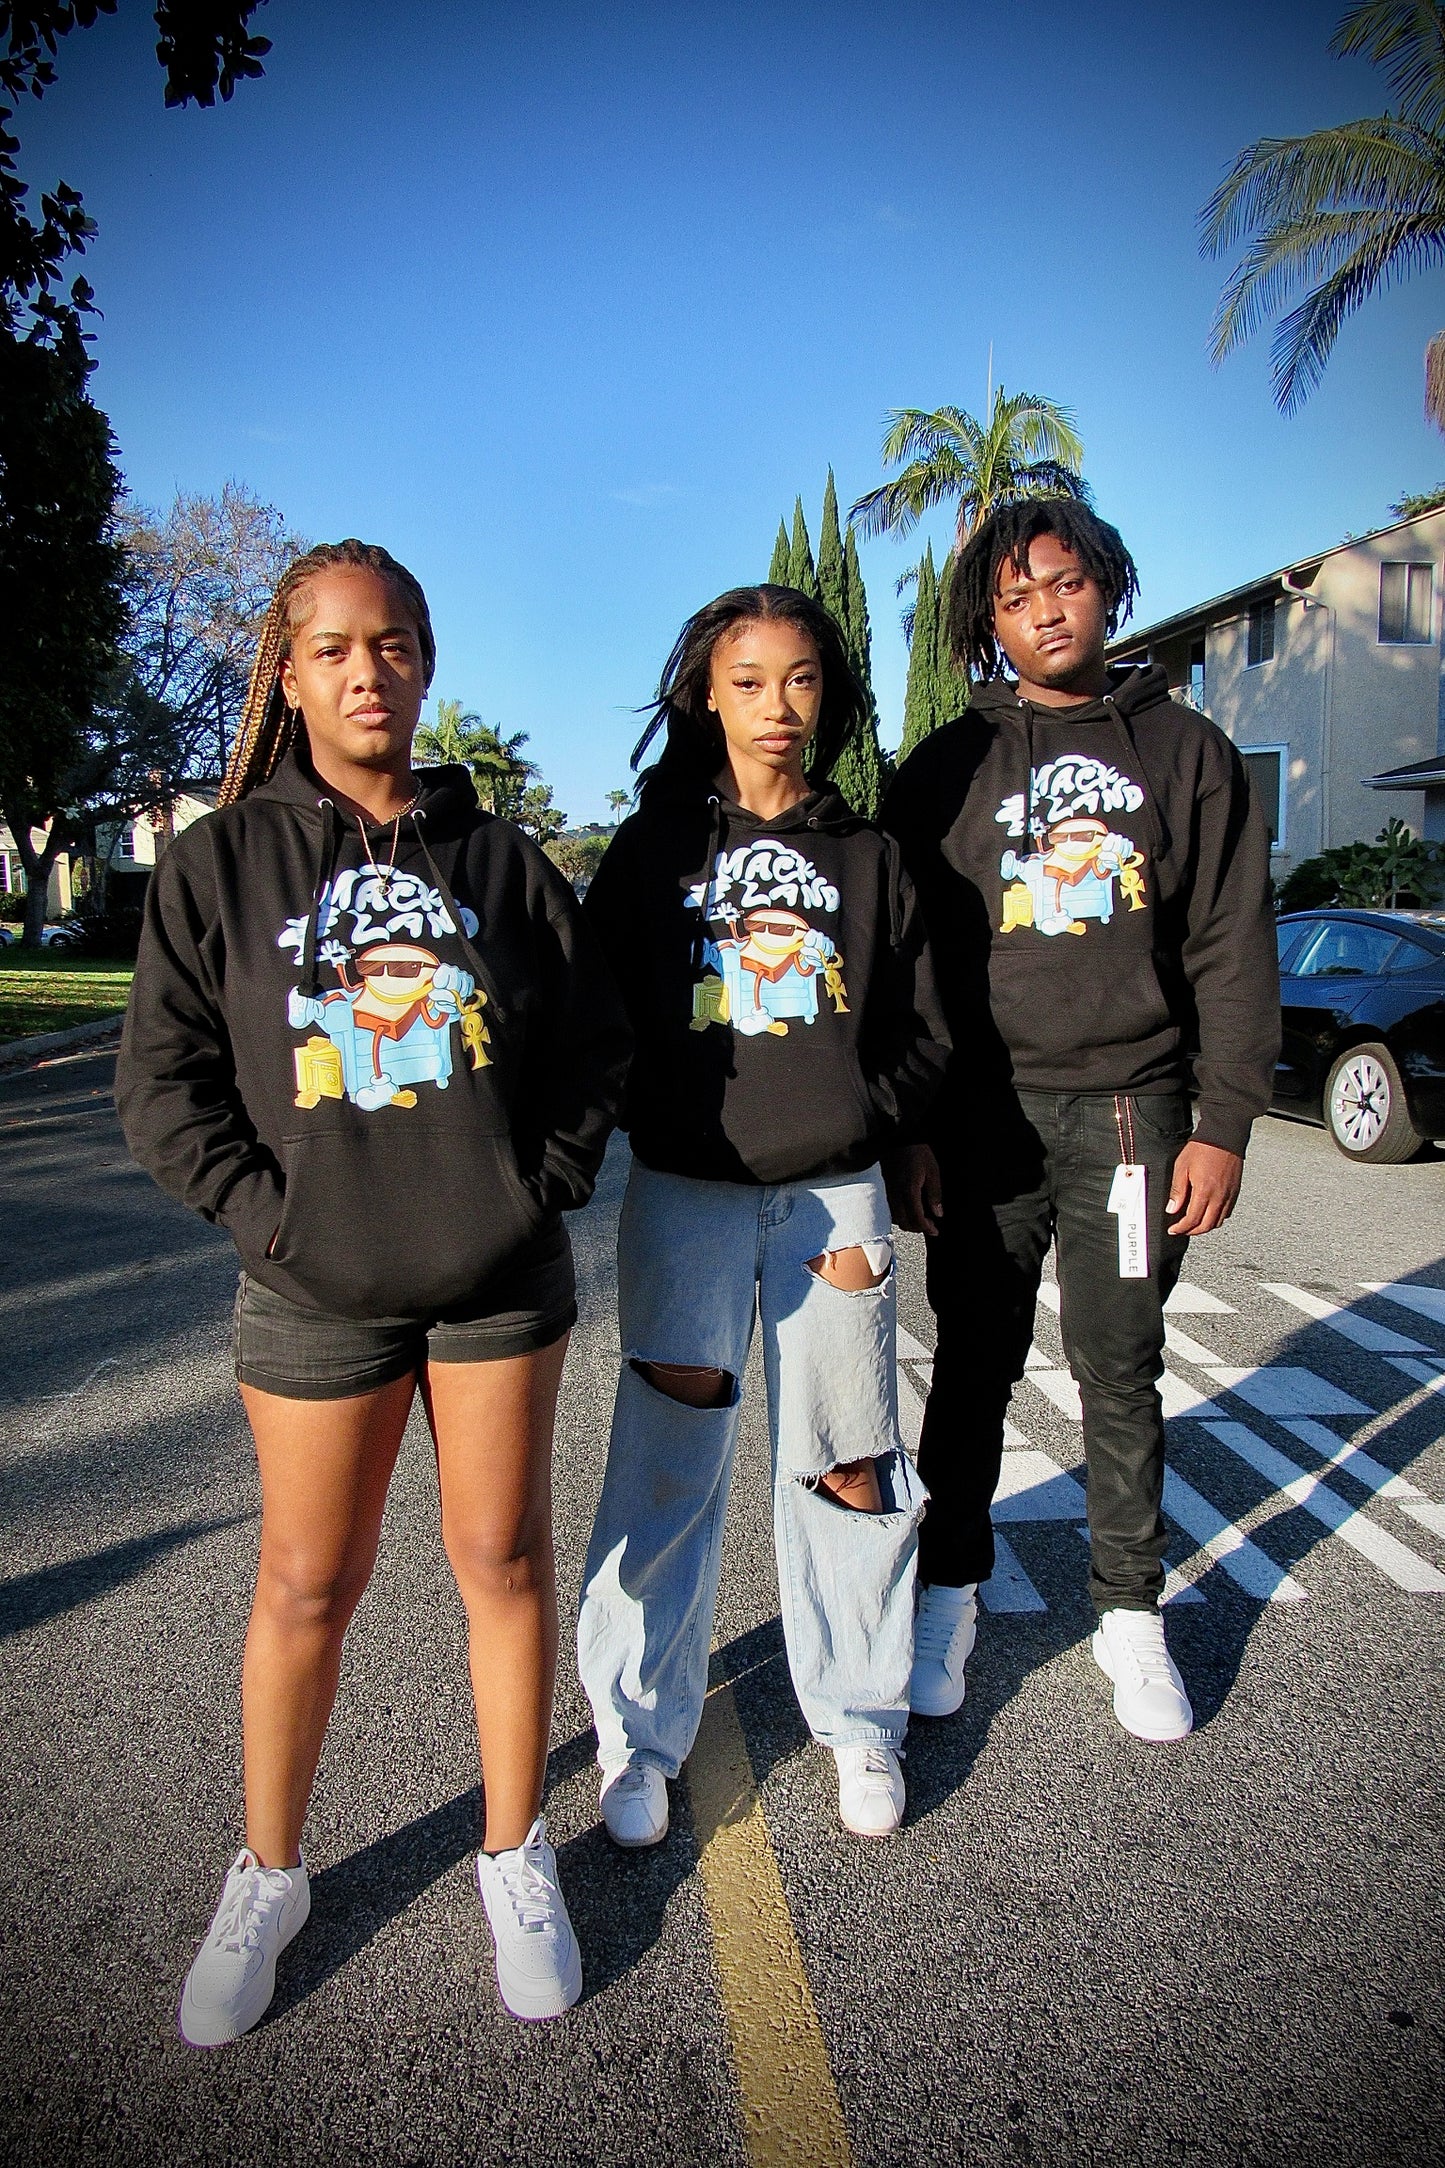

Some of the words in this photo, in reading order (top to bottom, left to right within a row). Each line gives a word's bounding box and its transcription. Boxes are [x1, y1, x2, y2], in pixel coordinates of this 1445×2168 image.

[1031, 754, 1119, 796] MACK
[1045, 777, 1145, 823] LAND
[715, 839, 817, 883] MACK
[316, 864, 443, 912] MACK
[739, 877, 841, 912] LAND
[1128, 1223, 1139, 1273] PURPLE
